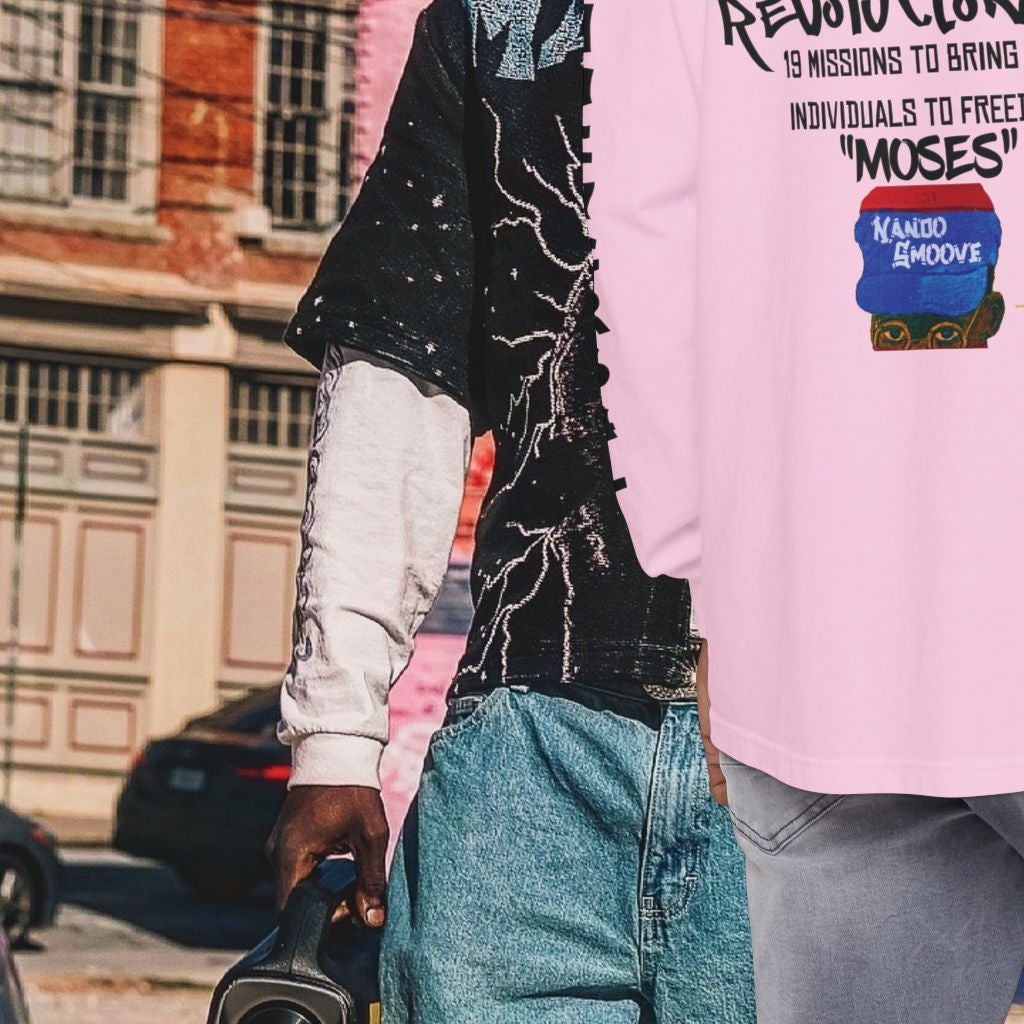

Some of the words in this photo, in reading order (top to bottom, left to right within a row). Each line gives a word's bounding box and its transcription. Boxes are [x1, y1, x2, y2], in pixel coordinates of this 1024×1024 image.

[783, 49, 802, 79] 19
[807, 46, 903, 79] MISSIONS
[909, 44, 940, 74] TO
[946, 40, 1020, 72] BRING
[790, 98, 918, 131] INDIVIDUALS
[923, 96, 954, 127] TO
[839, 126, 1018, 184] "MOSES"
[870, 215, 948, 244] NANDO
[891, 239, 982, 270] SMOOVE
